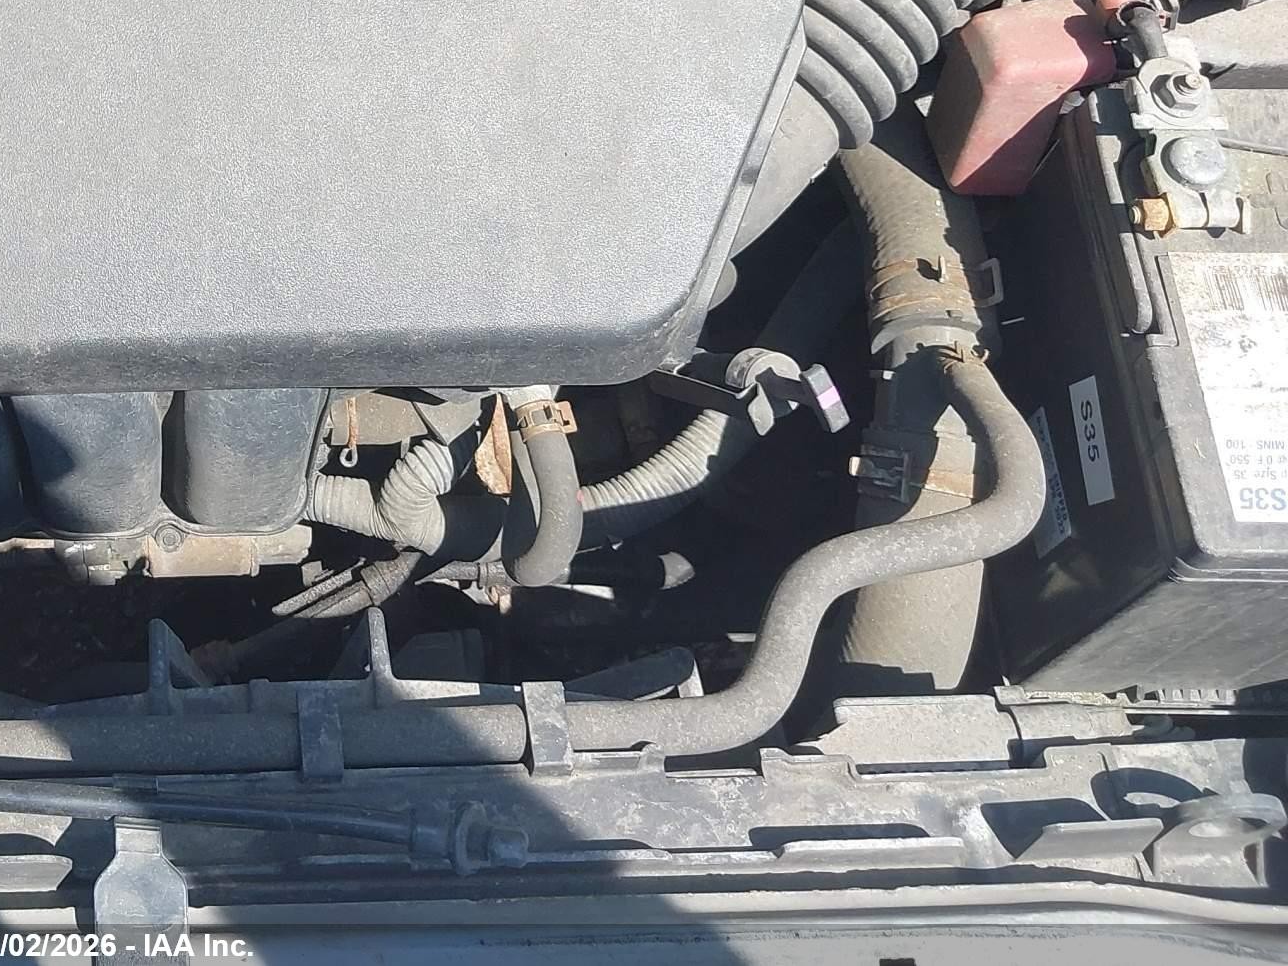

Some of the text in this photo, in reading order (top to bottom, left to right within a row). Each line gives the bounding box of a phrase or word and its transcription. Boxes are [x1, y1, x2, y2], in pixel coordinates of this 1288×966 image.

[1080, 400, 1100, 463] S35
[1225, 439, 1246, 450] 100
[1239, 487, 1287, 511] S35
